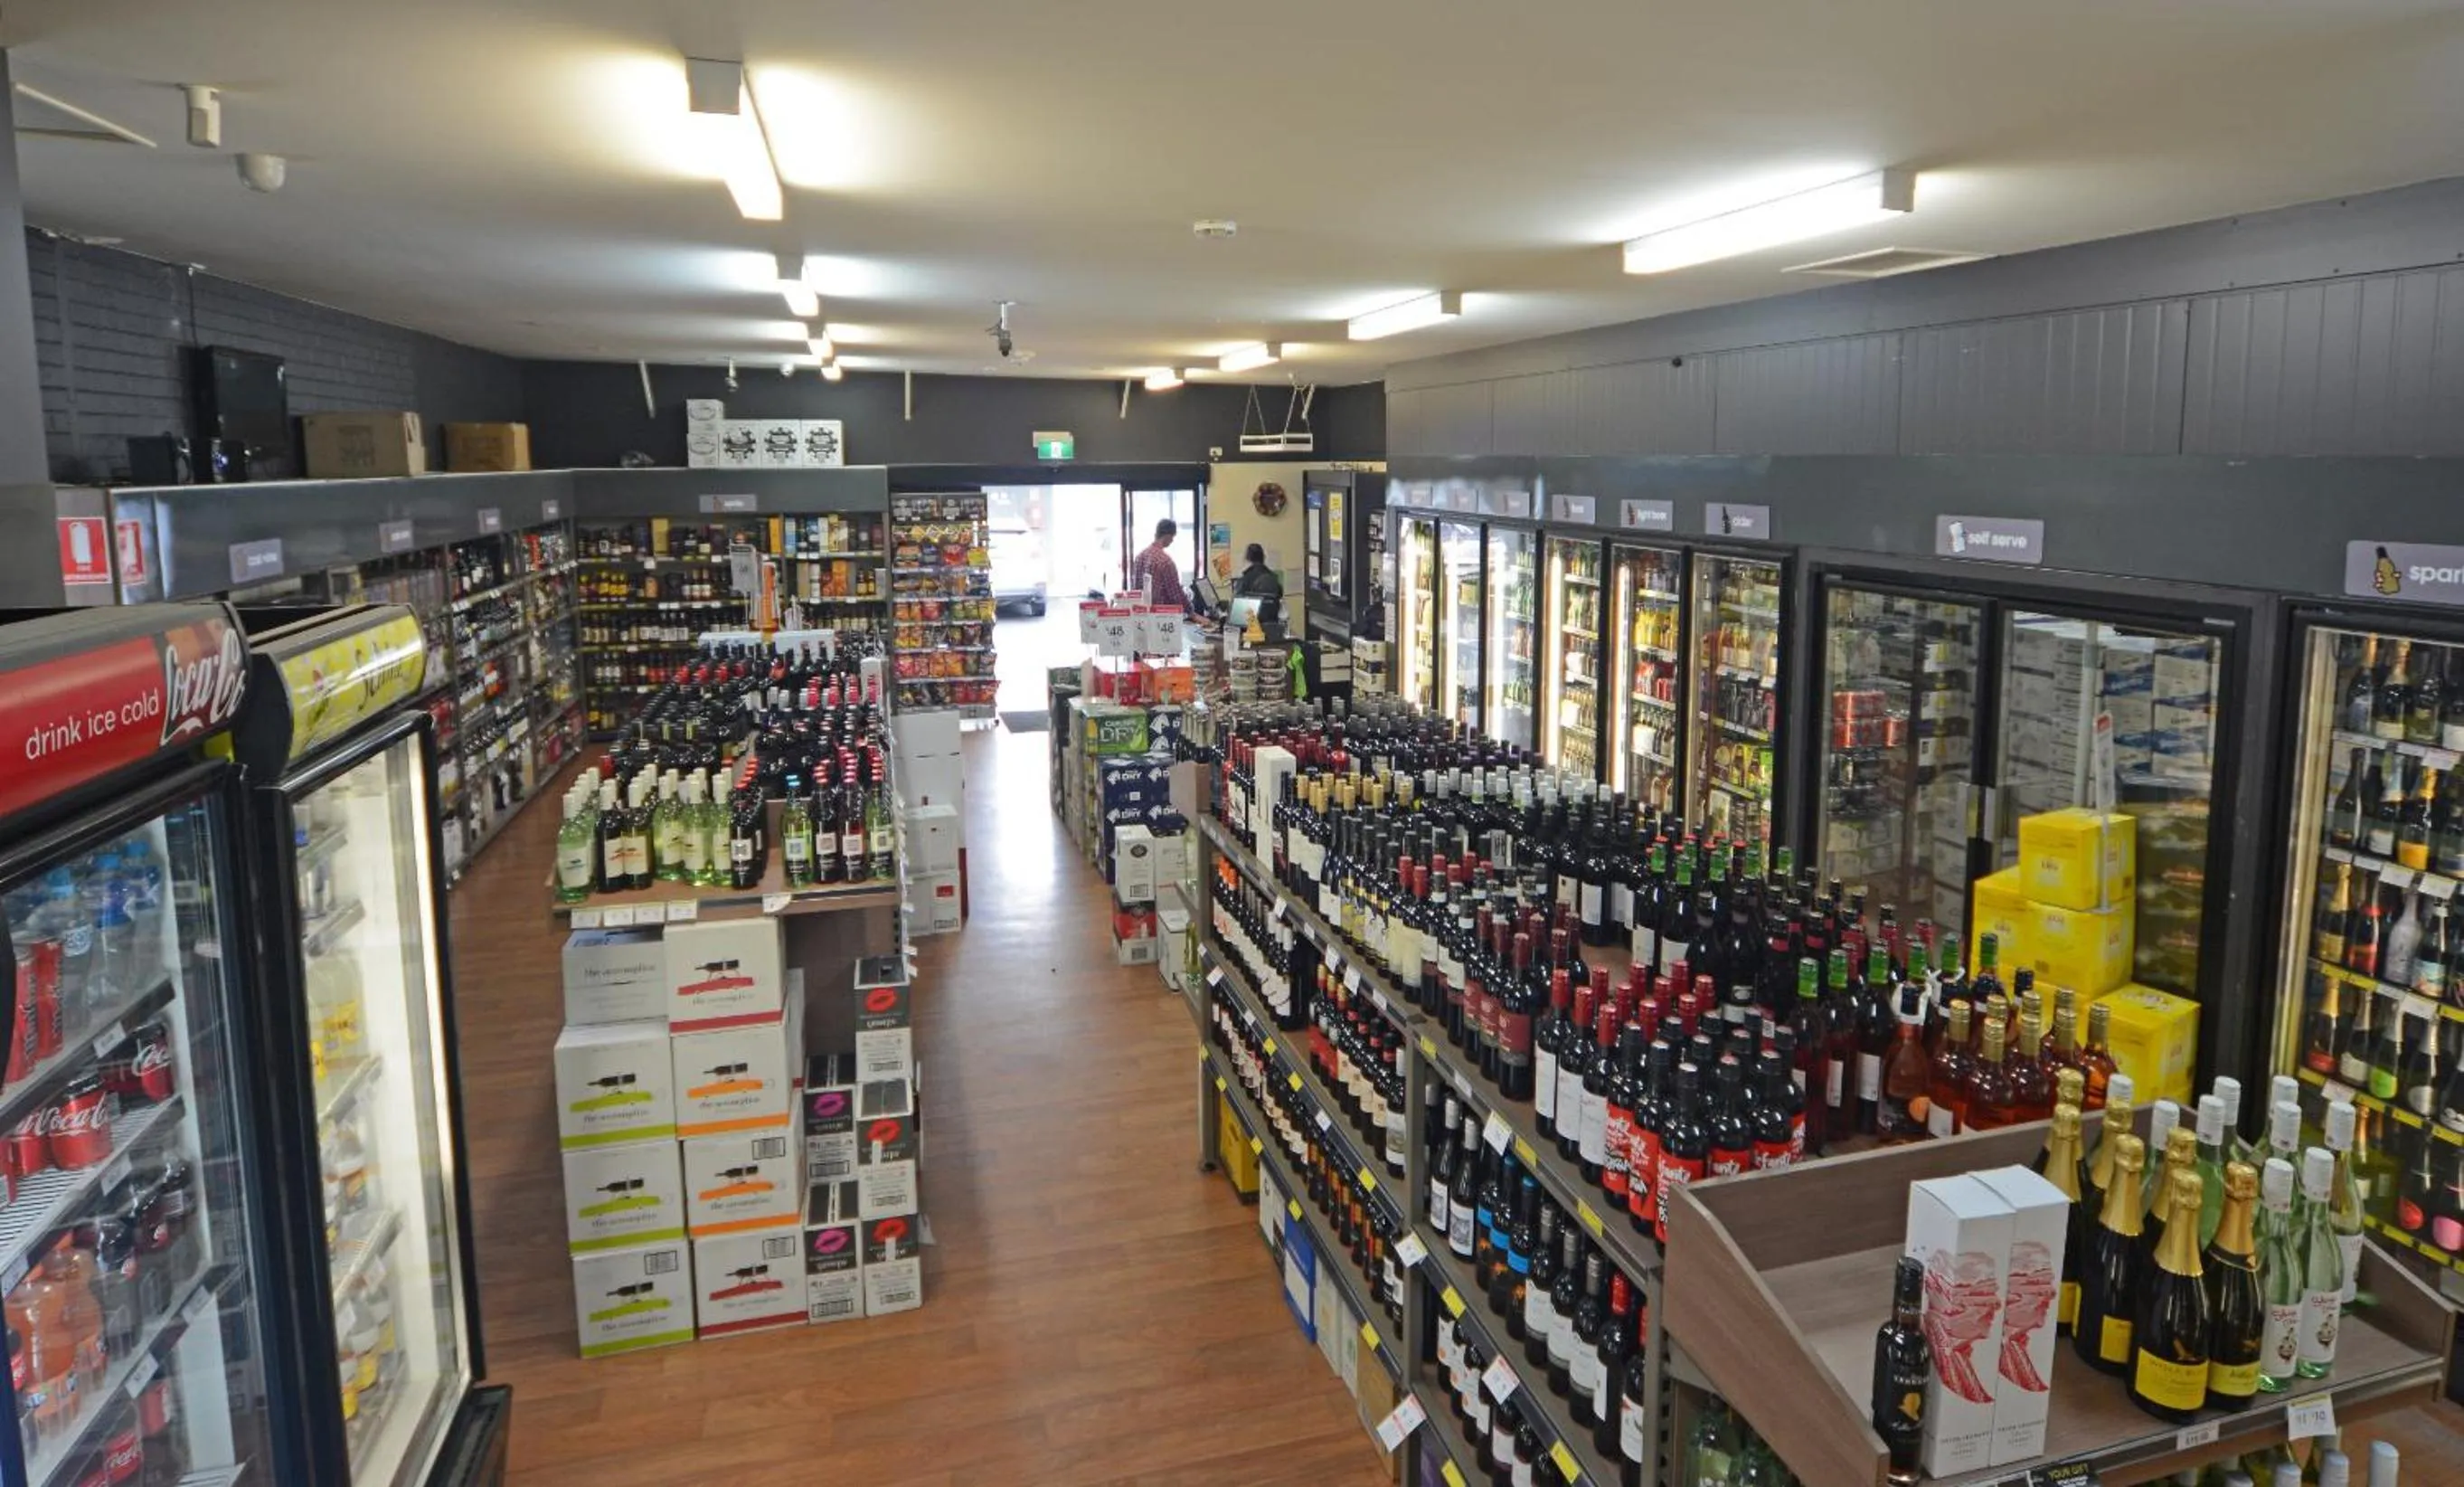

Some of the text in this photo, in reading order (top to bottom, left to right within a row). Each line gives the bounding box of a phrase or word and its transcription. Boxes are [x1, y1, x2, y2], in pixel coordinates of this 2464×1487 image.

[2409, 564, 2464, 584] spar
[25, 687, 159, 760] drink ice cold
